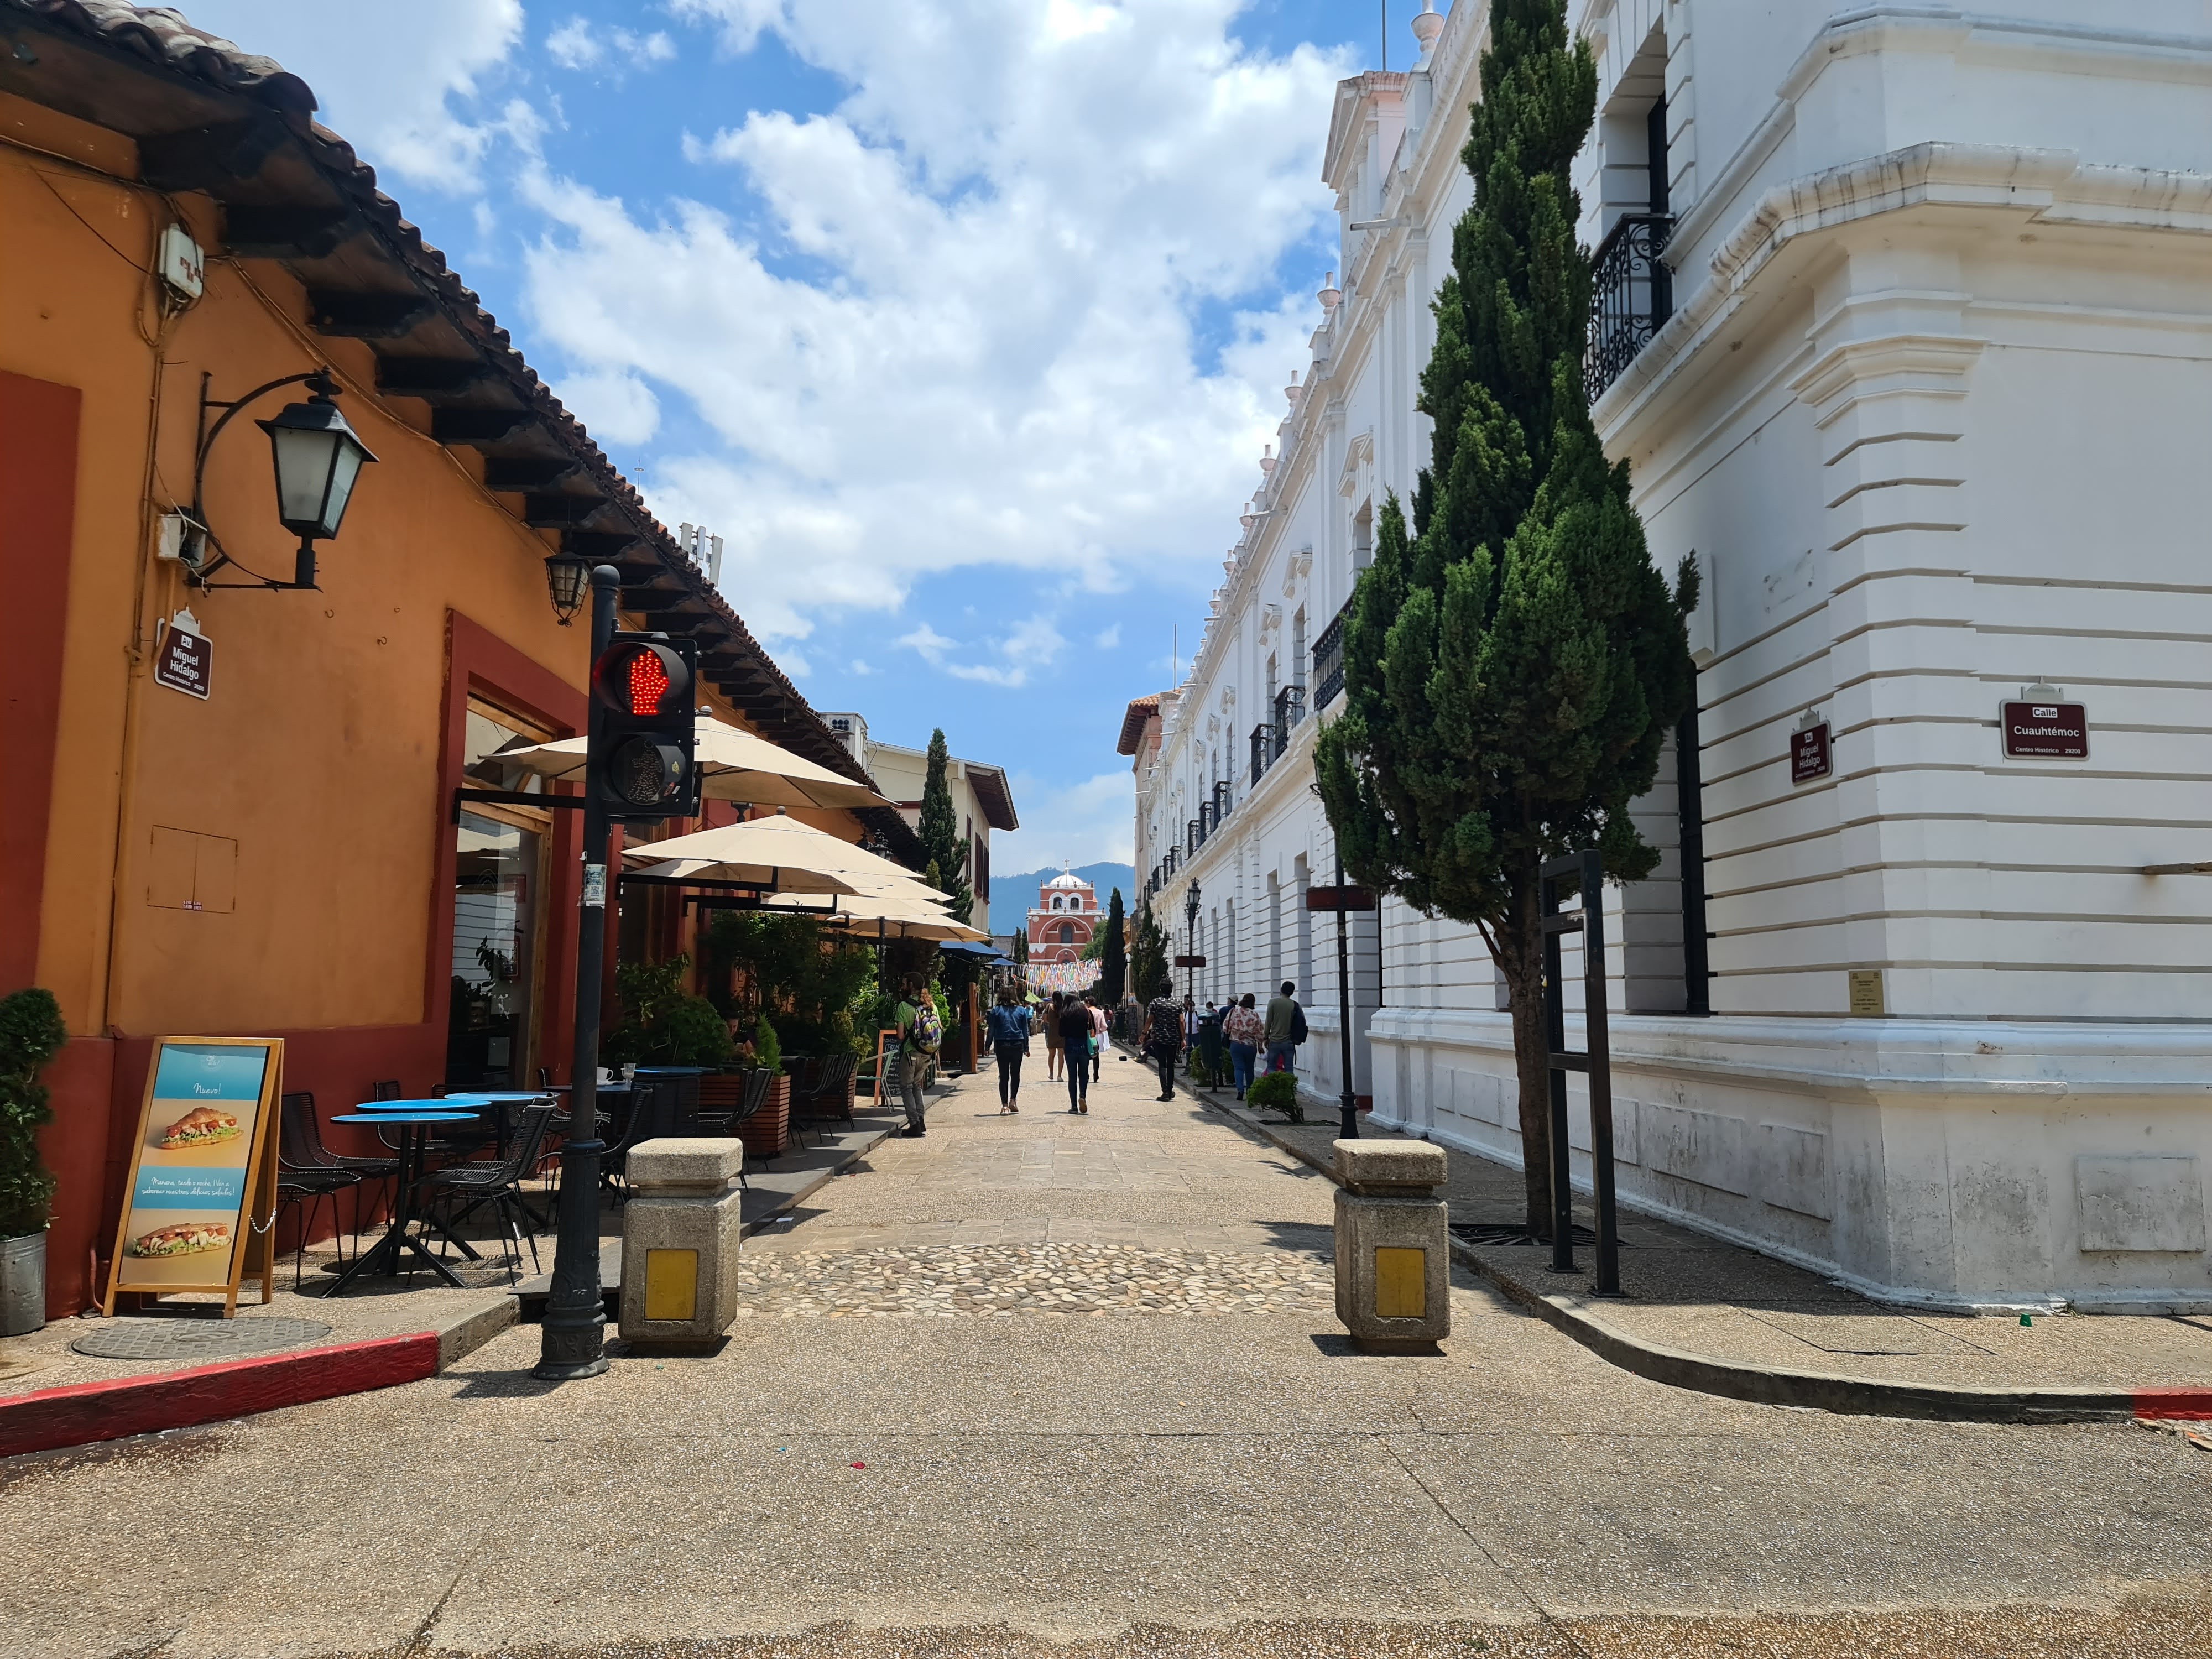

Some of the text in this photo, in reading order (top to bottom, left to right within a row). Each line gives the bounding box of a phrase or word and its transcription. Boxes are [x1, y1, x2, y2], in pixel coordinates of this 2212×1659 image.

[183, 637, 192, 647] Av.
[173, 646, 199, 666] Miguel
[170, 660, 199, 680] Hidalgo
[2034, 708, 2057, 717] Calle
[2014, 726, 2080, 737] Cuauhtémoc
[1800, 743, 1819, 757] Miguel
[1799, 755, 1821, 769] Hidalgo
[193, 1082, 221, 1094] Nuevo!
